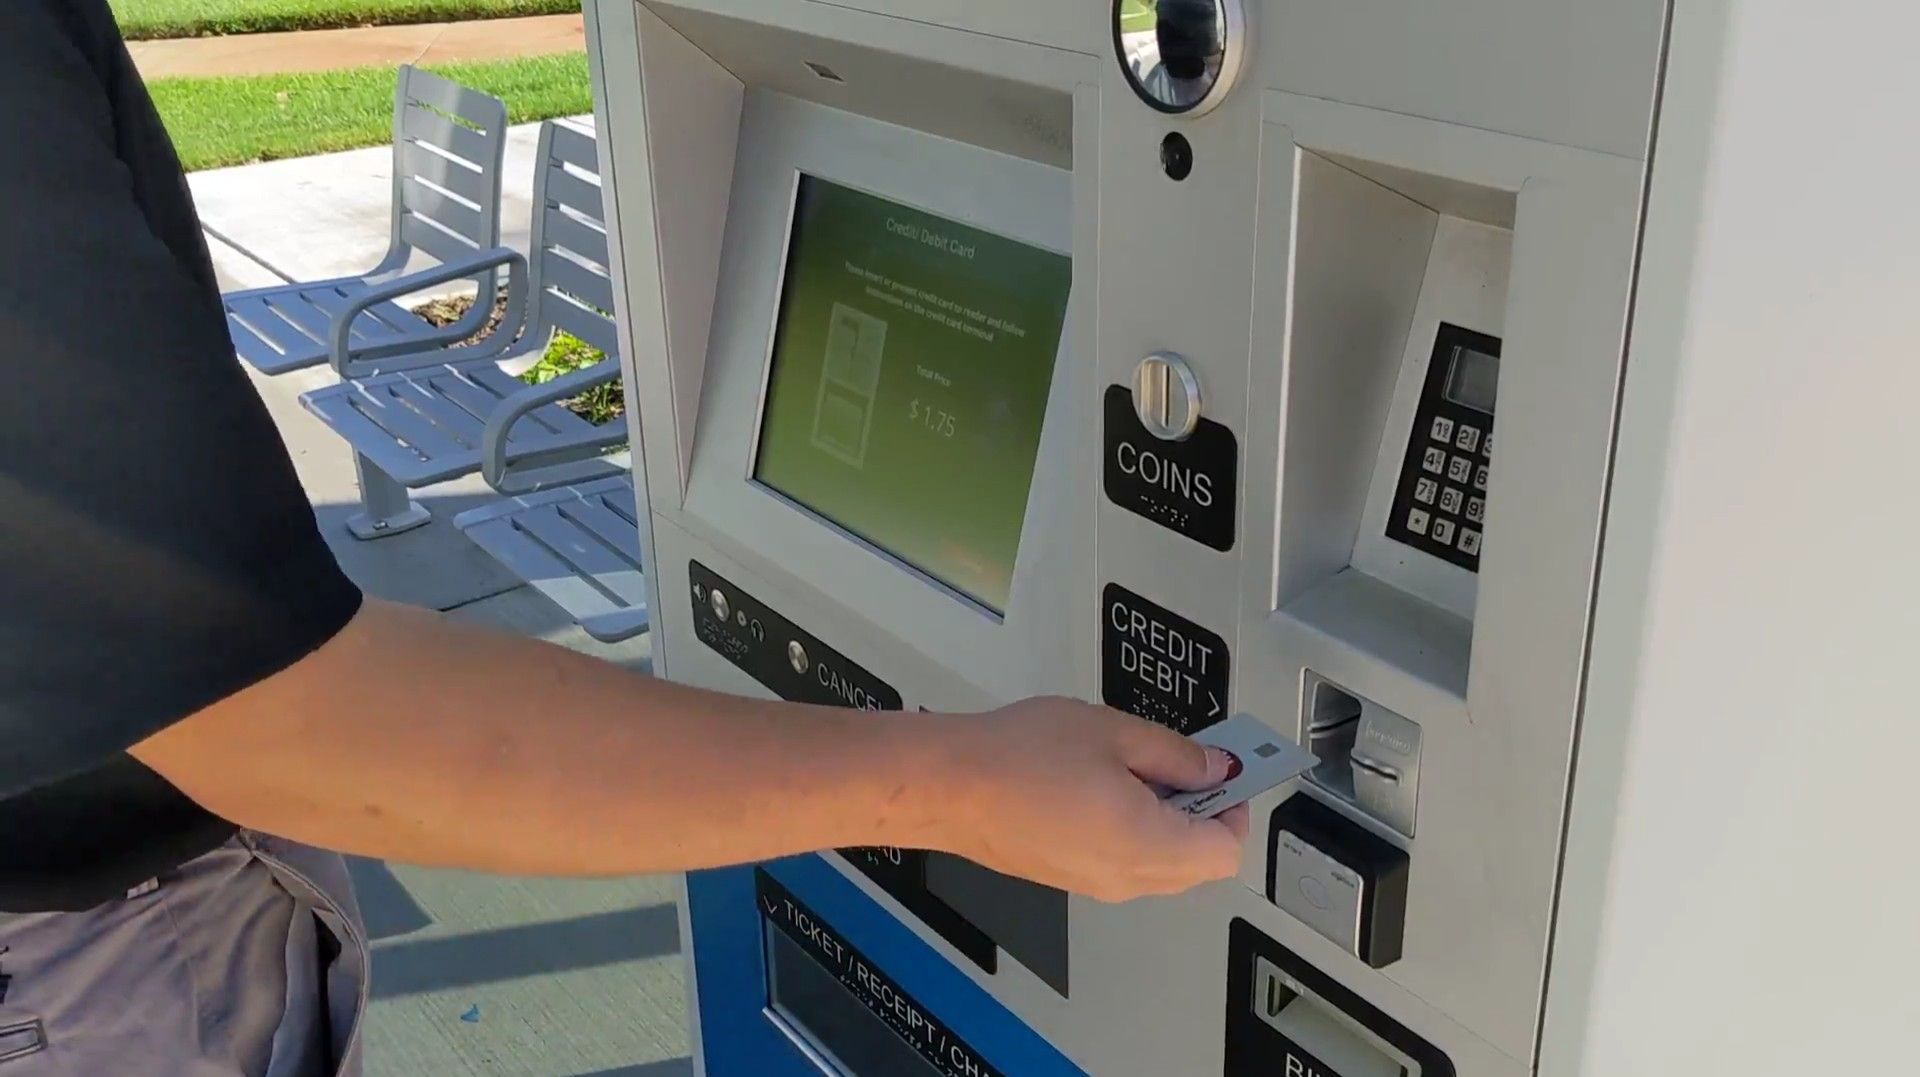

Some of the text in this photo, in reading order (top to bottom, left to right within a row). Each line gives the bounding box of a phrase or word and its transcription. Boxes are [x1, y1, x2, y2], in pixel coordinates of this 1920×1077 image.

[921, 228, 948, 251] Debit
[950, 239, 976, 259] Card
[938, 297, 953, 311] card
[946, 315, 962, 331] card
[910, 398, 956, 437] $ 1.75
[1117, 441, 1213, 507] COINS
[1476, 470, 1488, 485] 6
[1434, 522, 1445, 538] 0
[1111, 602, 1213, 675] CREDIT
[1121, 640, 1199, 705] DEBIT
[784, 899, 844, 964] TICKET
[857, 962, 936, 1043] RECEIPT
[951, 1045, 989, 1077] CH
